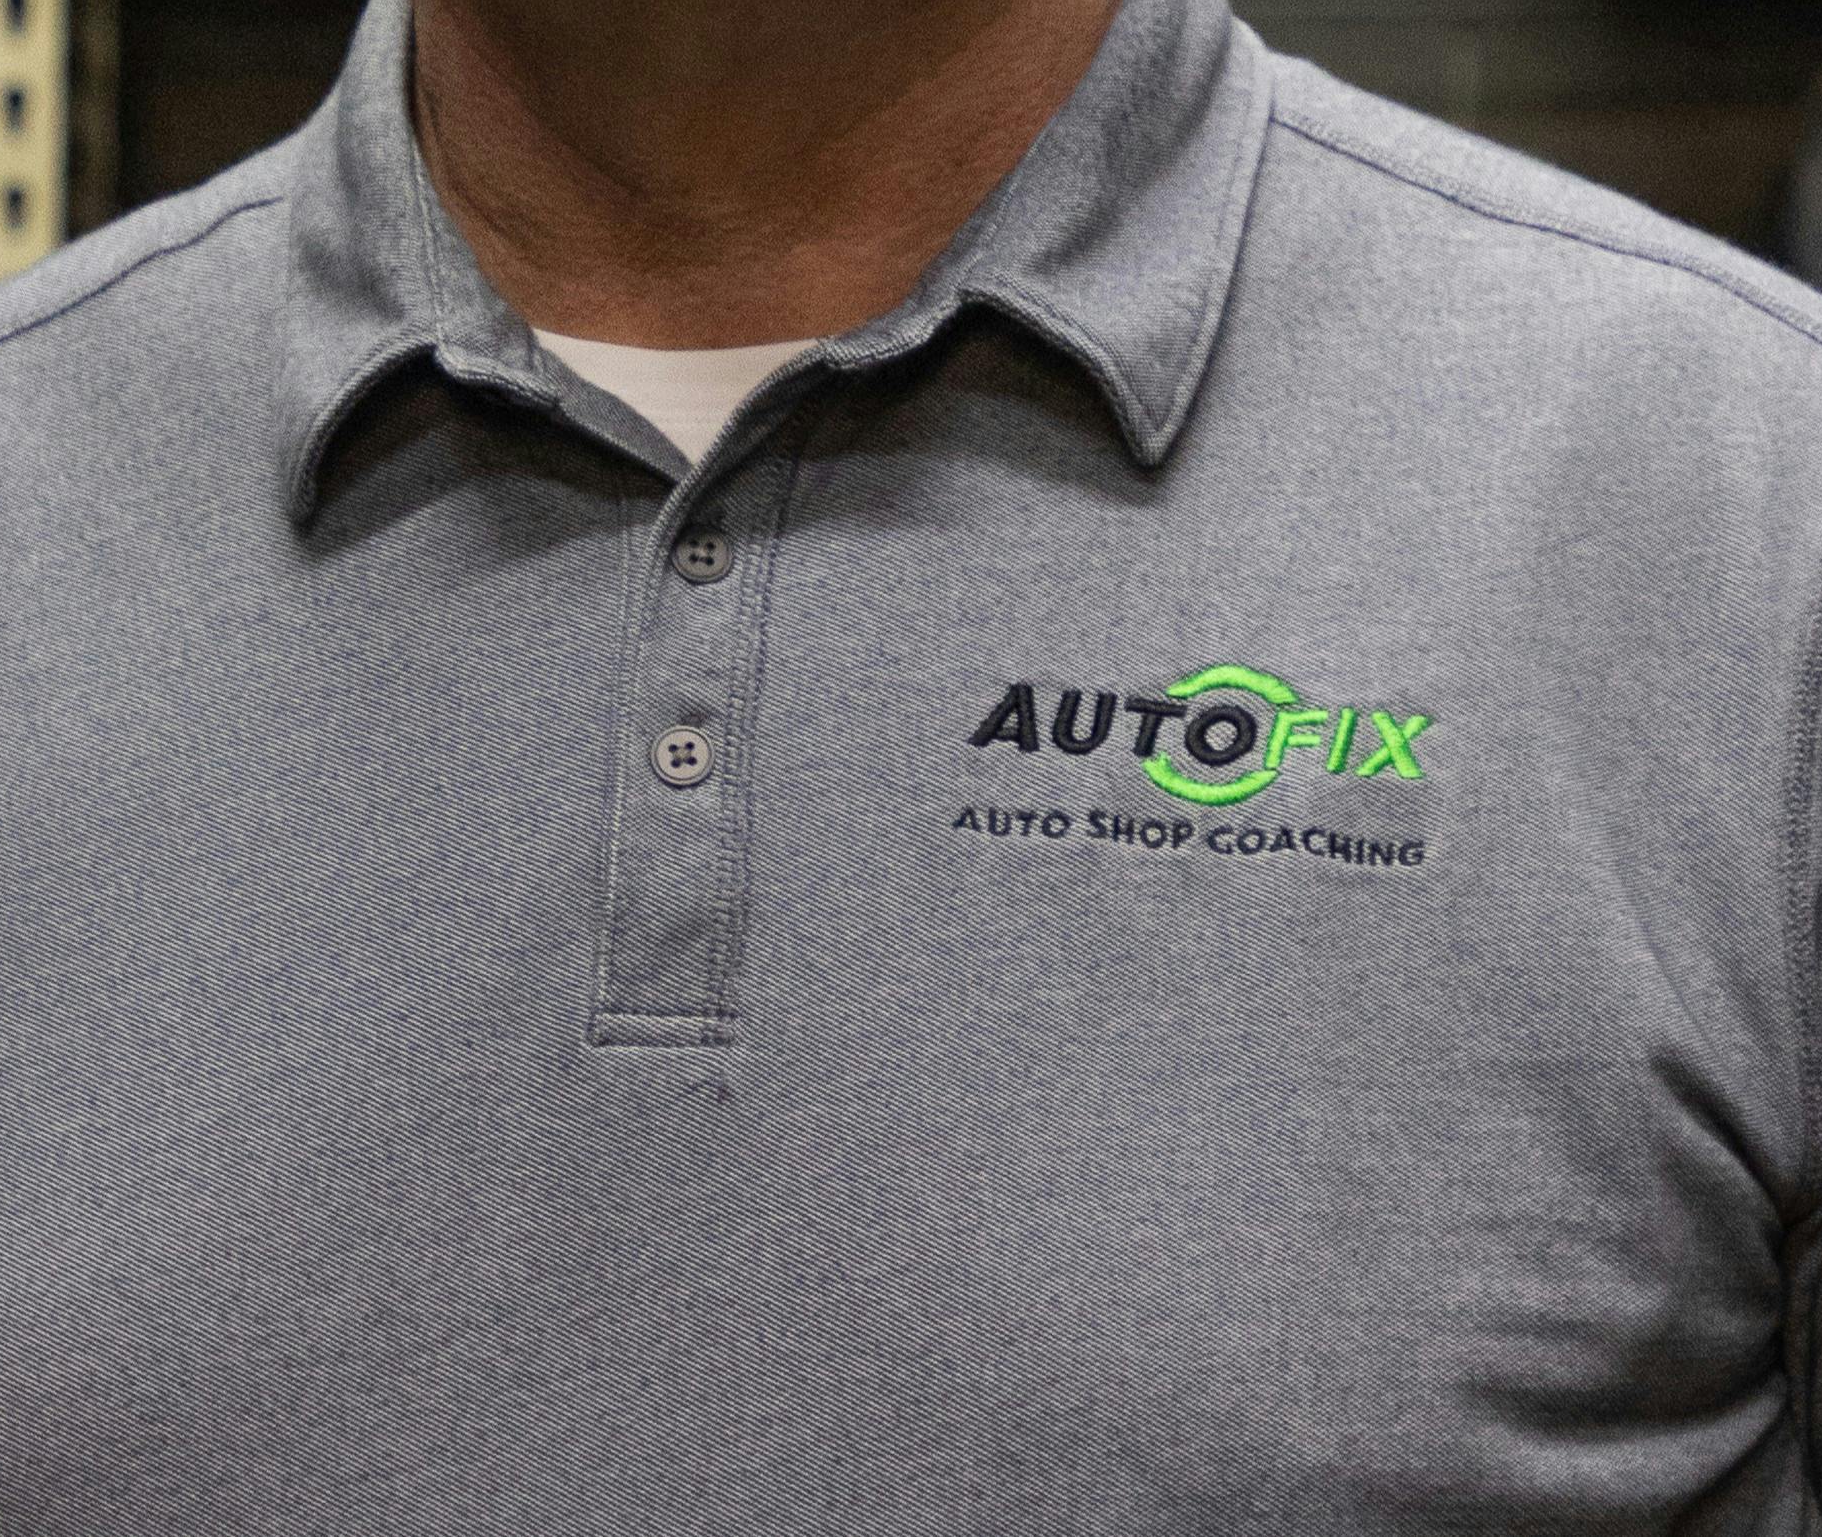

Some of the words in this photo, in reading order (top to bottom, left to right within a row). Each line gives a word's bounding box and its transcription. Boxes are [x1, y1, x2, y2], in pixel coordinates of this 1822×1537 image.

[969, 682, 1433, 780] AUTOFIX
[953, 805, 1072, 839] AUTO
[1084, 810, 1196, 851] SHOP
[1206, 824, 1427, 868] COACHING
